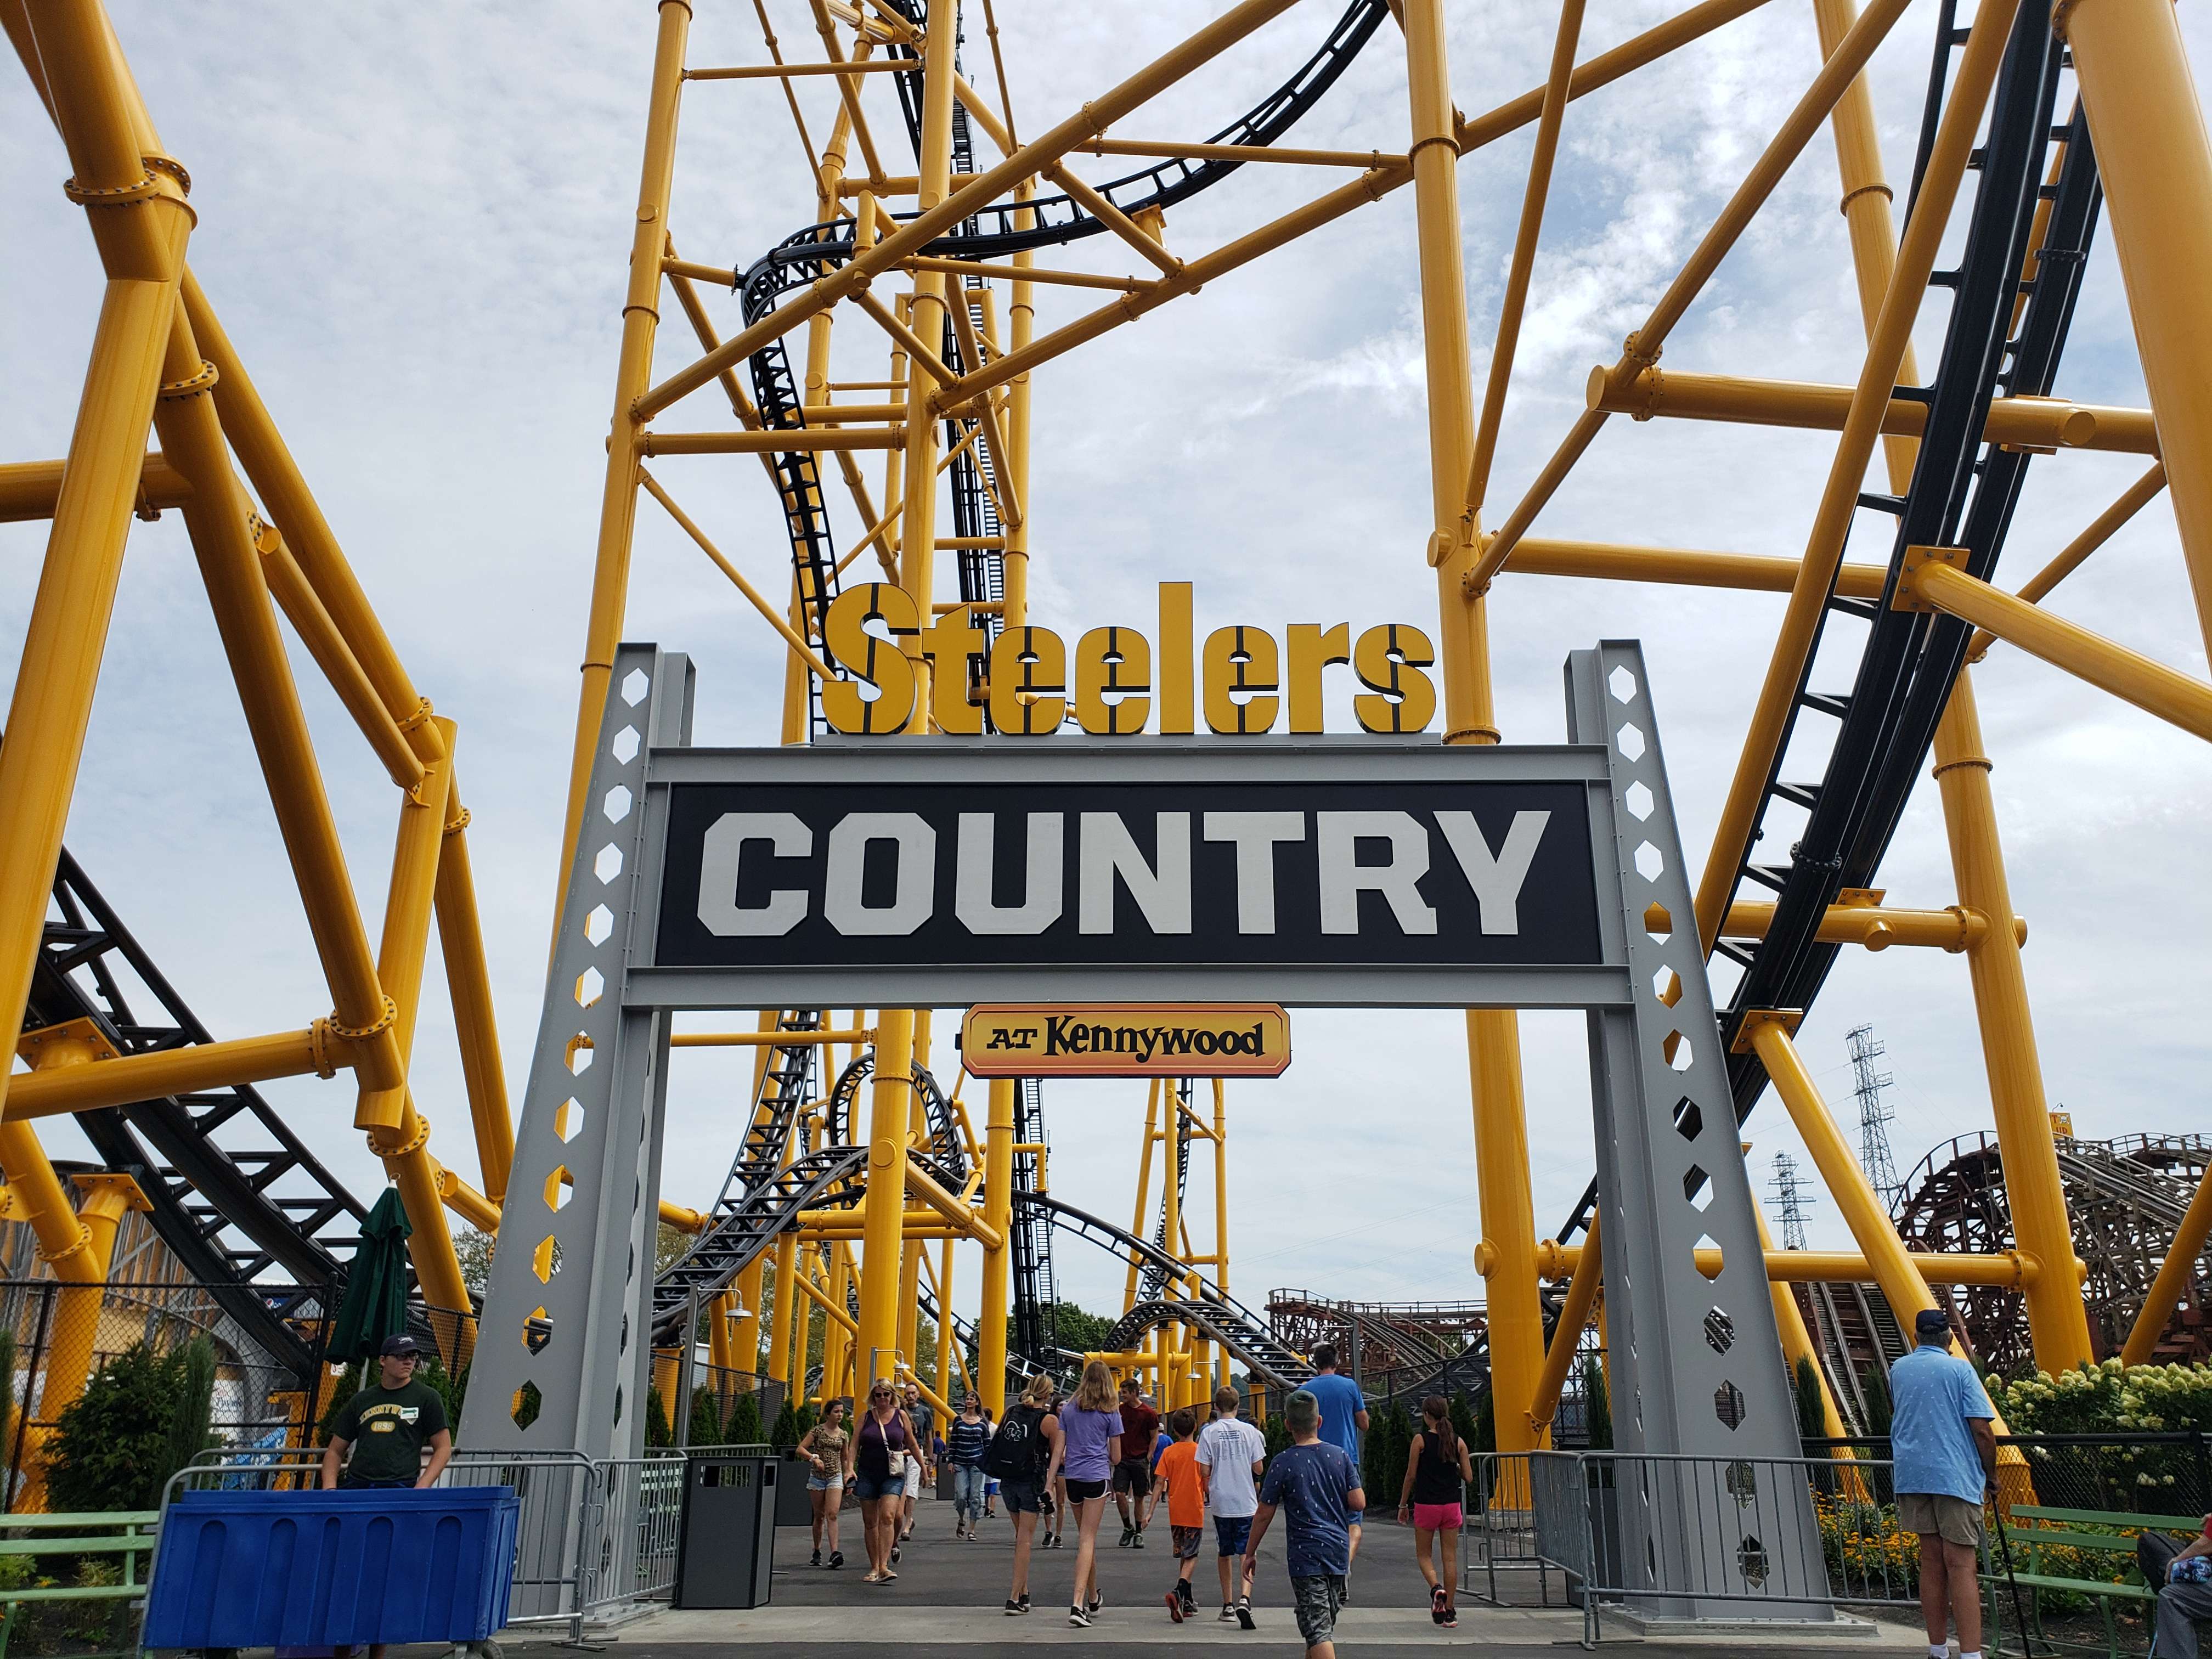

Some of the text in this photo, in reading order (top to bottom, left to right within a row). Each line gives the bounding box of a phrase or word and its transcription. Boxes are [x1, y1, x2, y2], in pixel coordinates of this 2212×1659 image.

[822, 582, 1436, 734] Steelers
[697, 810, 1551, 936] COUNTRY
[987, 1015, 1266, 1063] AT Kennywood
[375, 1421, 393, 1430] 1898
